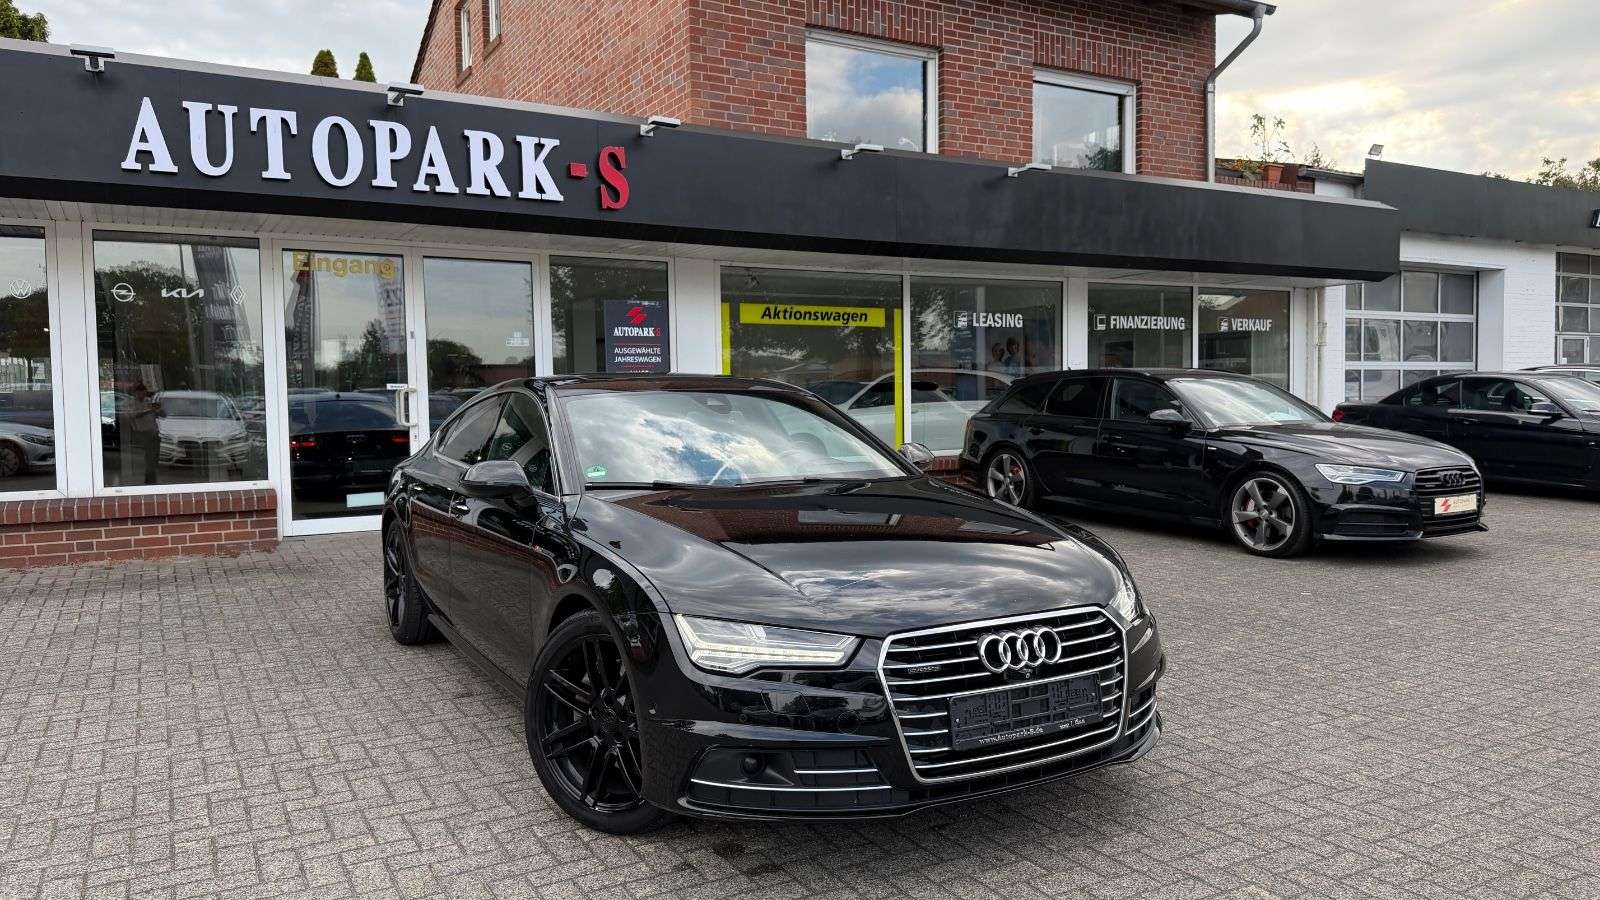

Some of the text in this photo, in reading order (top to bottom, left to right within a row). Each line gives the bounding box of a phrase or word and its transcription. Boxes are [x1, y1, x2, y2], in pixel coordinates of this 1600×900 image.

[292, 251, 396, 280] Eingang
[761, 306, 868, 324] Aktionswagen
[972, 312, 1024, 328] LEASING
[1109, 314, 1186, 331] FINANZIERUNG
[1231, 317, 1273, 332] VERKAUF
[614, 347, 661, 355] AUSGEWÄHLTE
[614, 355, 662, 363] JAHRESWAGEN
